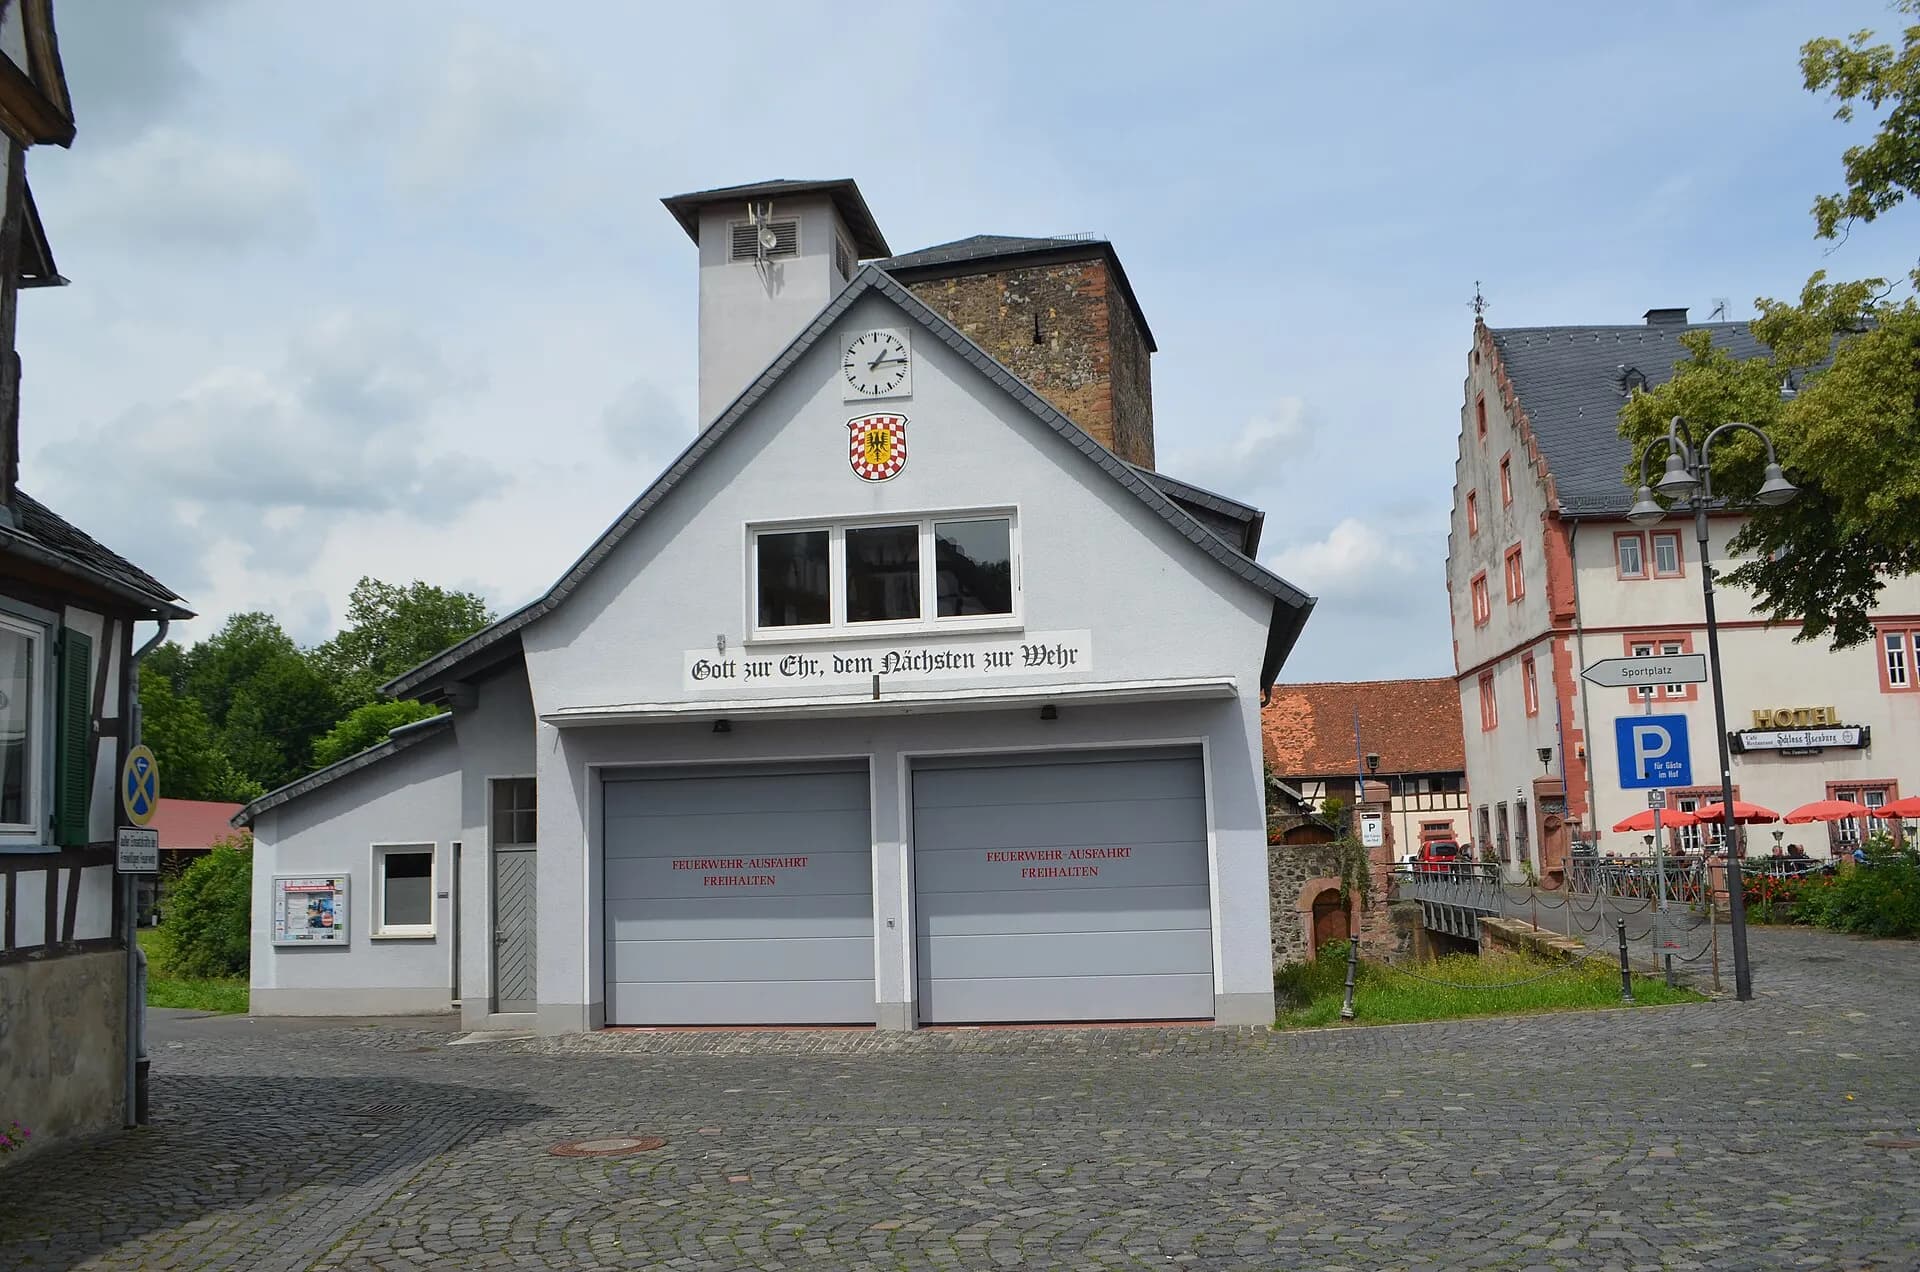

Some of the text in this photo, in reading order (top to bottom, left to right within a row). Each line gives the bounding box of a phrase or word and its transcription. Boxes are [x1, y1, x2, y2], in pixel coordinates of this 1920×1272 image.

[691, 643, 1079, 683] Gott zur Ehr, dem Nächsten zur Wehr
[1621, 666, 1672, 679] Sportplatz
[1752, 706, 1842, 729] HOTEL
[1777, 733, 1803, 746] Schloss
[1632, 725, 1672, 780] P
[1654, 762, 1664, 770] für
[1658, 770, 1667, 778] im
[1368, 823, 1376, 832] P
[986, 847, 1132, 862] FEUERWEHR-AUSFAHRT
[672, 856, 808, 870] FEUERWEHR-AUSFAHRT
[1021, 865, 1099, 879] FREIHALTEN
[703, 875, 776, 887] FREIHALTEN
